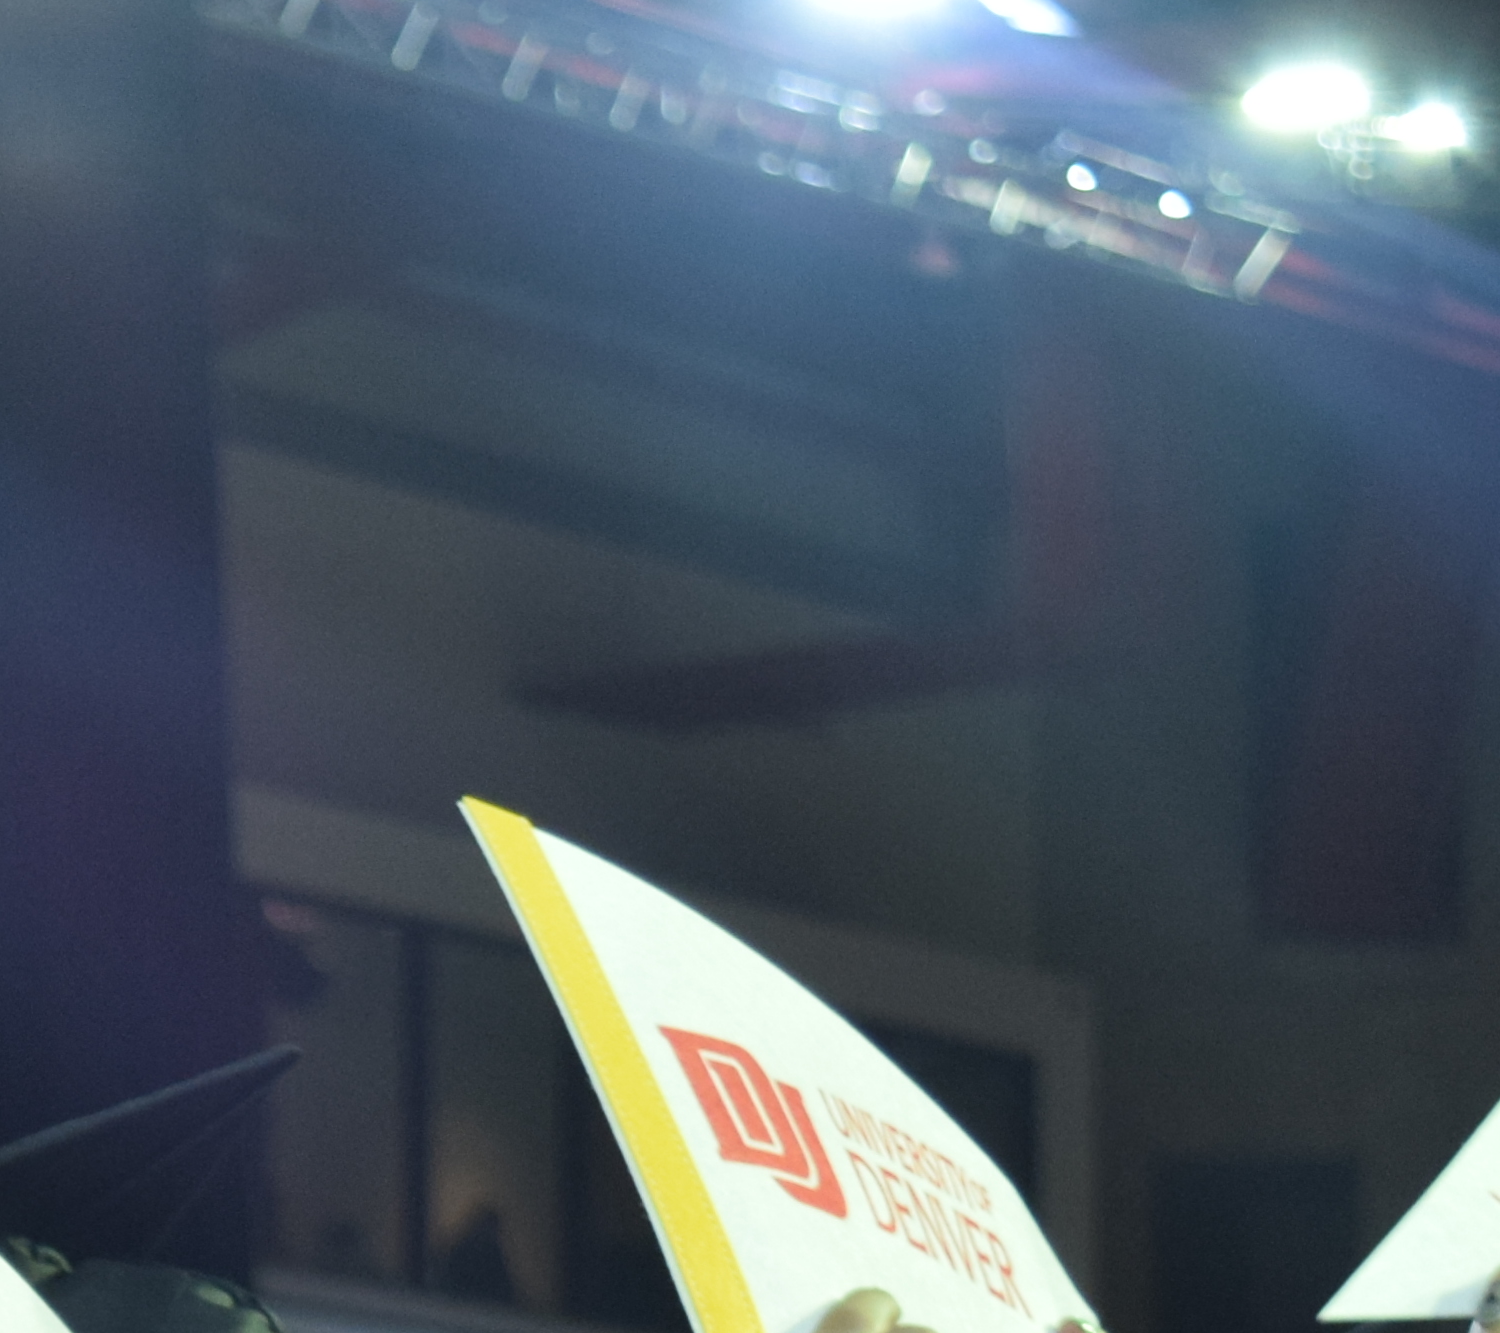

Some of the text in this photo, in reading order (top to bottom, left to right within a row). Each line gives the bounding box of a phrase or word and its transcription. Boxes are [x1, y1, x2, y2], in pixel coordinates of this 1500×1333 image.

[657, 1024, 848, 1220] DU
[817, 1087, 993, 1213] UNIVERSITY OF
[845, 1147, 1034, 1320] DENVER
